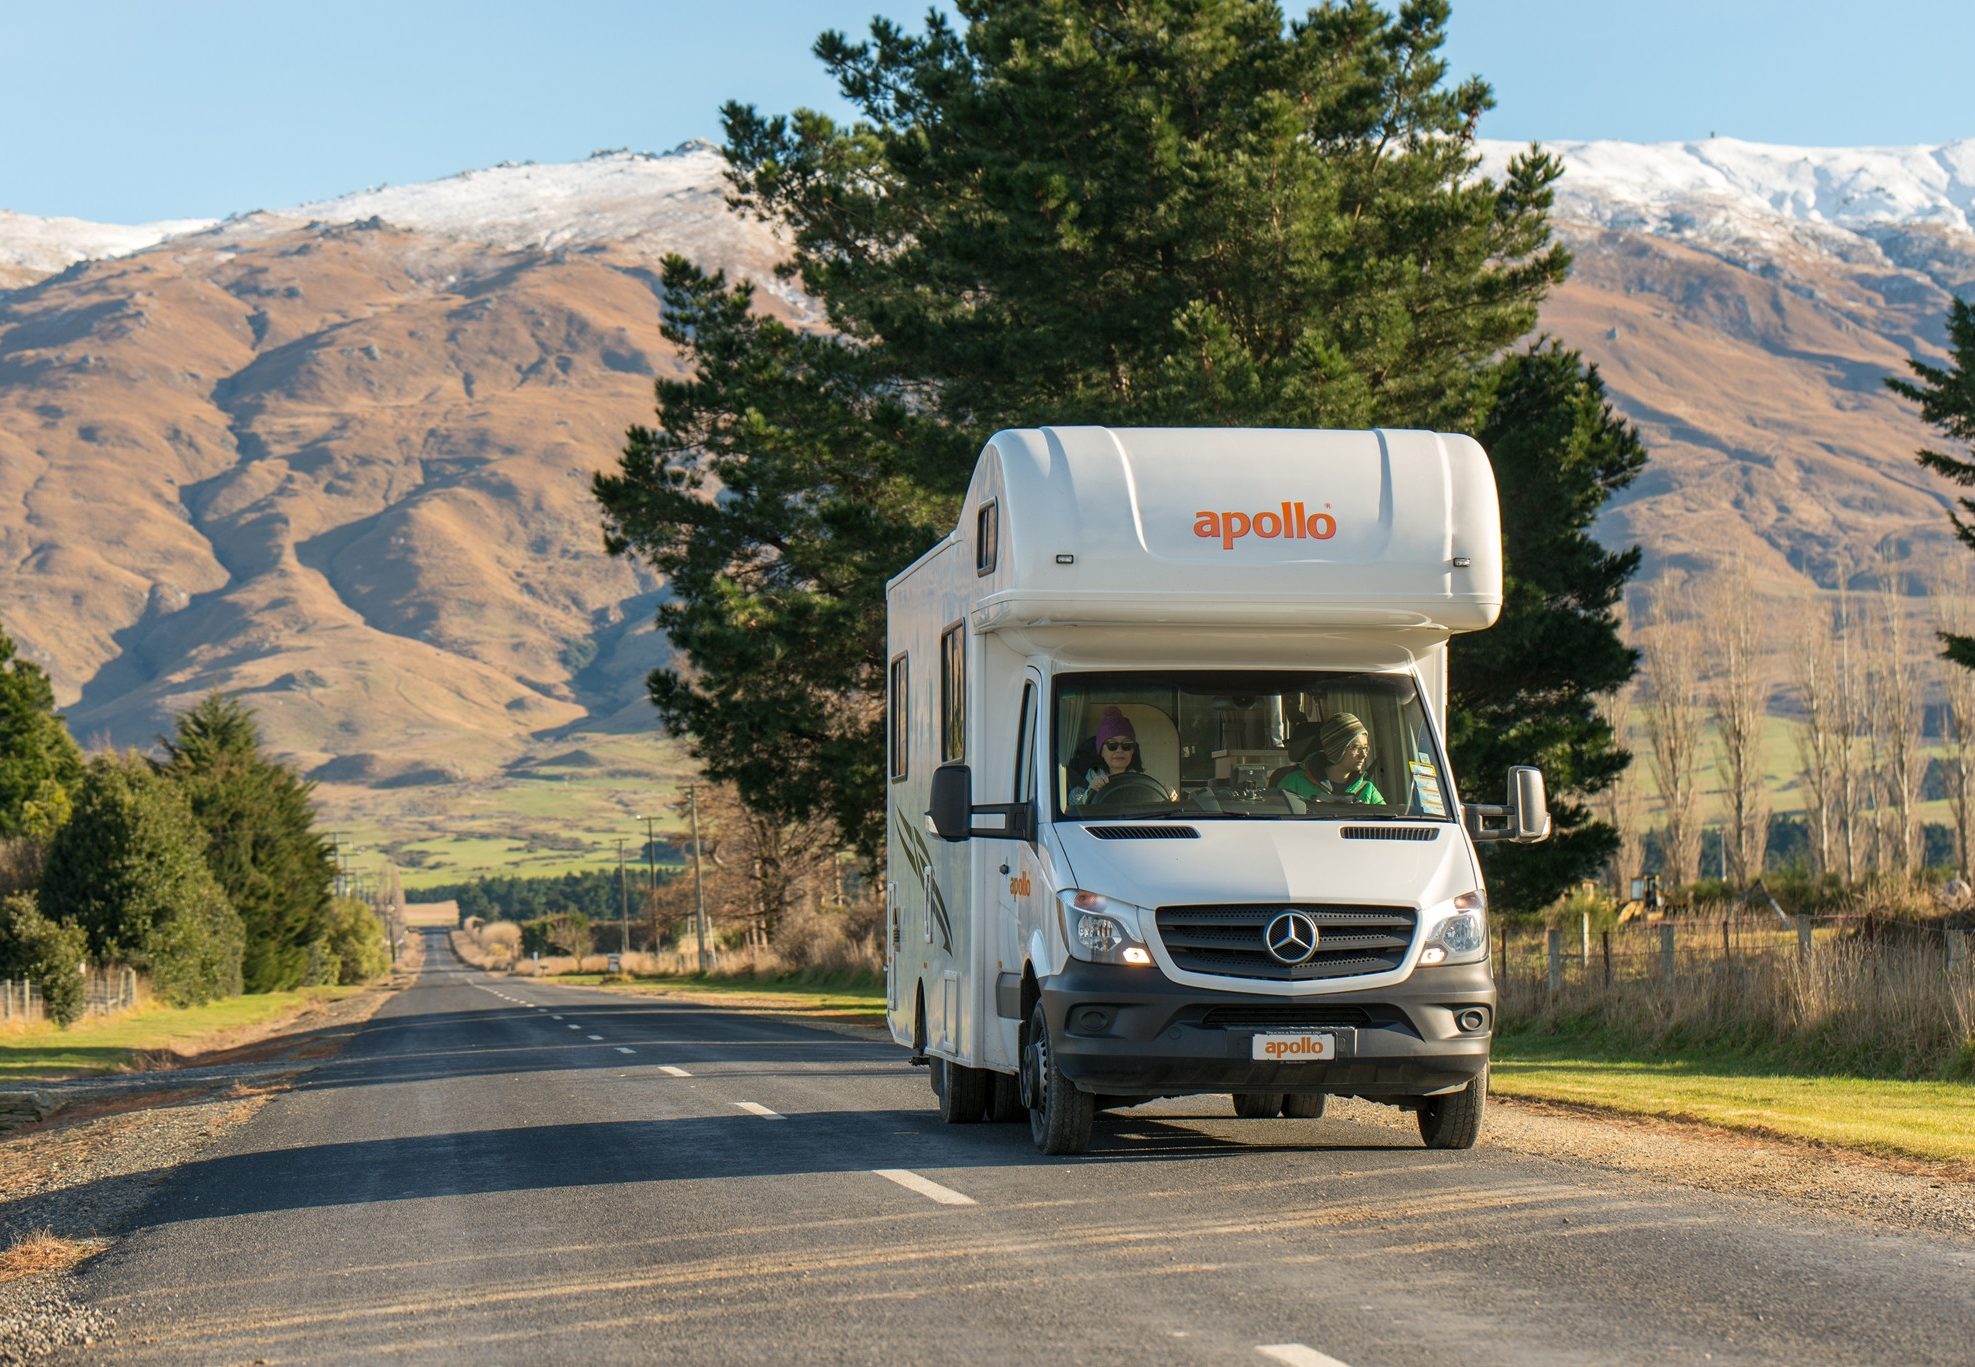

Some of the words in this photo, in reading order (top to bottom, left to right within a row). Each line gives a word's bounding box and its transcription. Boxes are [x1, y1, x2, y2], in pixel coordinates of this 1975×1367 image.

[1193, 502, 1336, 550] apollo
[1009, 870, 1031, 902] apollo
[1265, 1037, 1324, 1059] apollo
